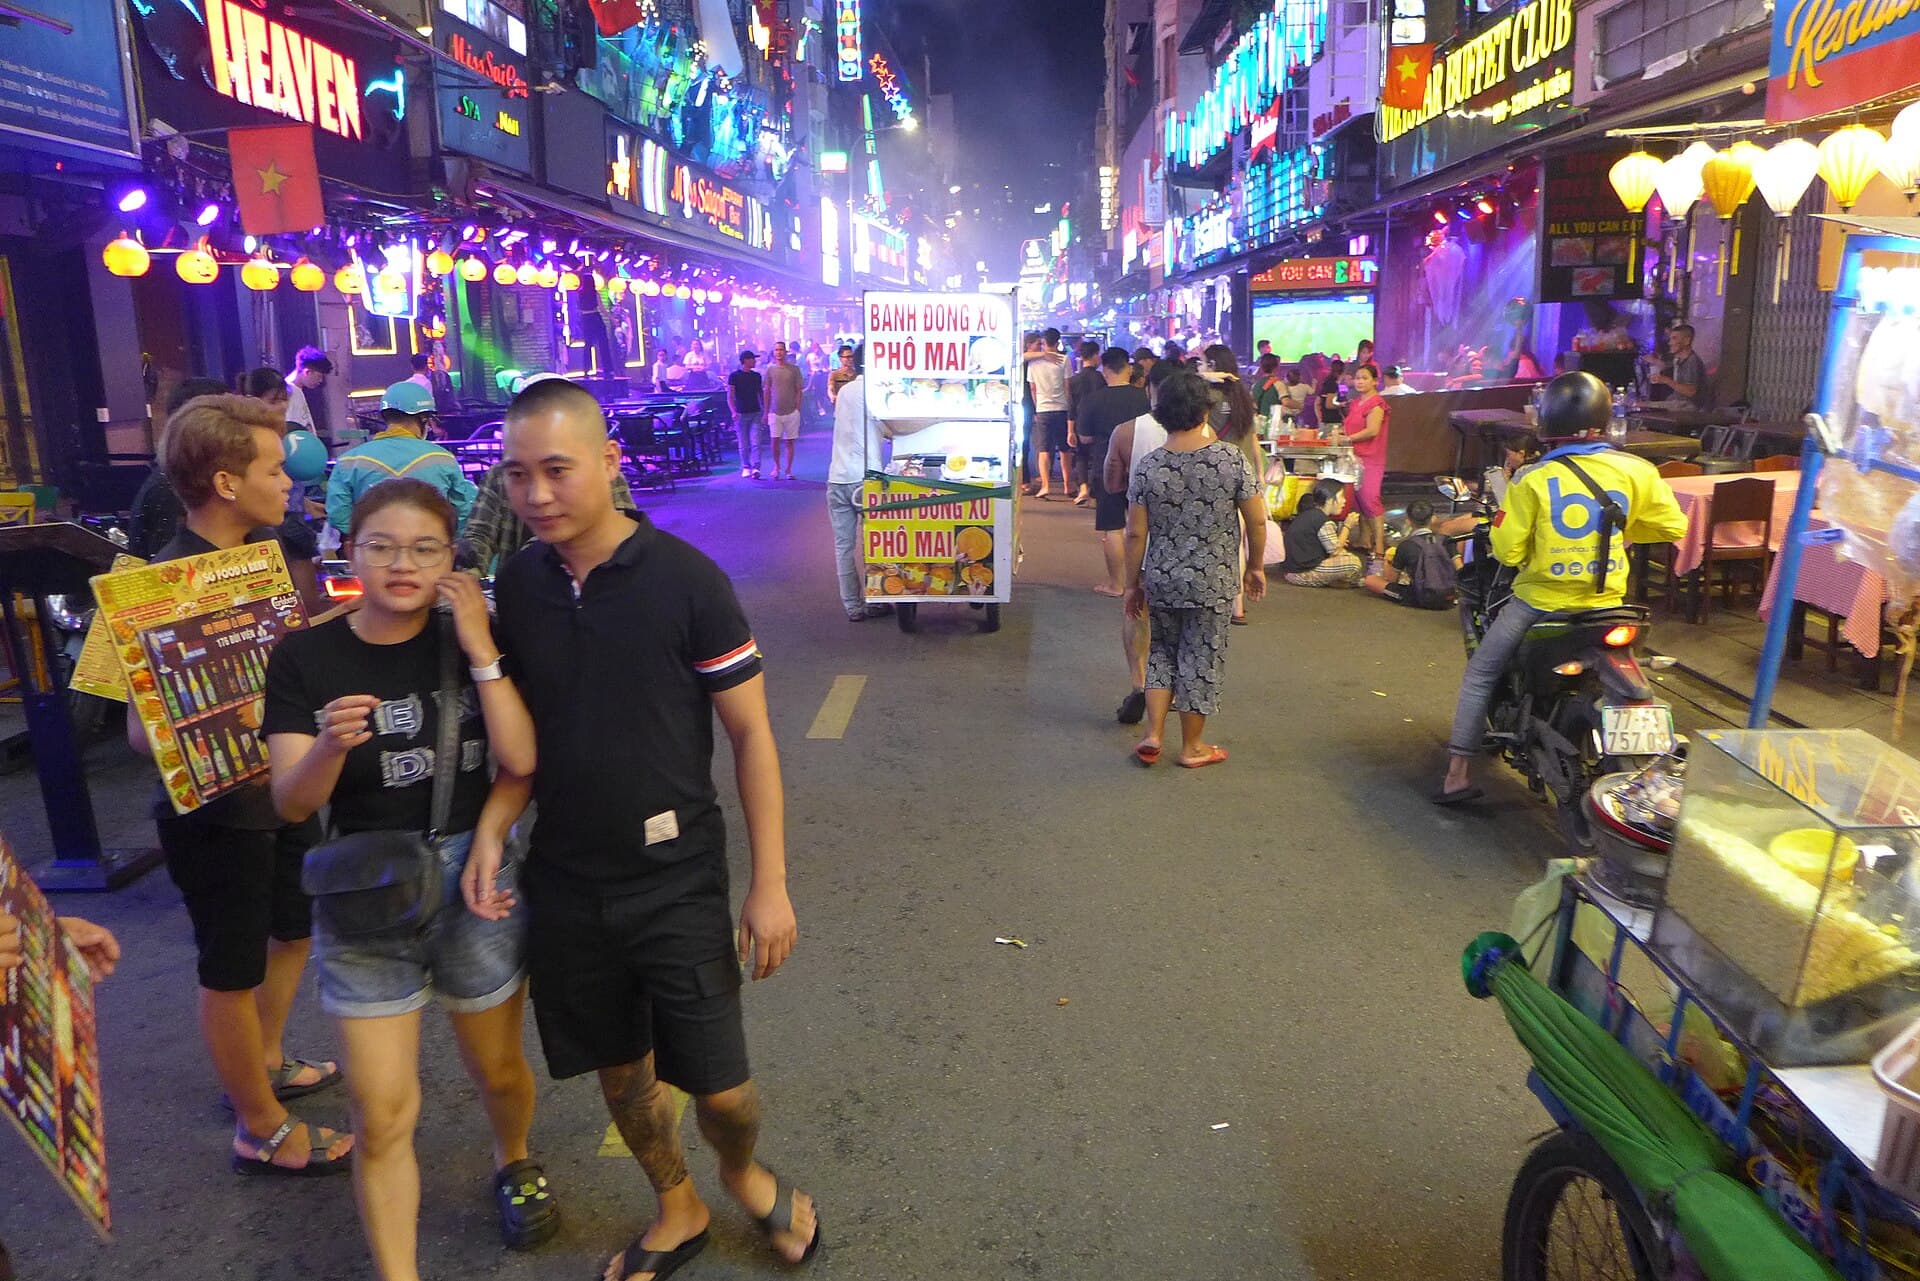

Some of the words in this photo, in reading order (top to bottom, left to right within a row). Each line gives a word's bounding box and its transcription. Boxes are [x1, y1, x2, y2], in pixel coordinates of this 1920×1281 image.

[453, 33, 485, 74] Miss
[1444, 16, 1513, 110] BUFFET
[1511, 0, 1572, 73] CLUB
[205, 0, 363, 142] HEAVEN
[463, 95, 481, 120] SPA
[1549, 223, 1569, 235] ALL
[1573, 221, 1595, 233] YOU
[1598, 220, 1619, 232] CAN
[1280, 266, 1303, 281] YOU
[1307, 265, 1333, 279] CAN
[1335, 260, 1378, 283] EAT
[873, 336, 916, 371] PHÔ
[925, 342, 967, 371] MAI
[868, 525, 909, 558] PHÔ
[915, 531, 953, 558] MAI
[202, 572, 216, 583] SG
[216, 566, 241, 580] FOOD
[247, 559, 269, 573] BEER
